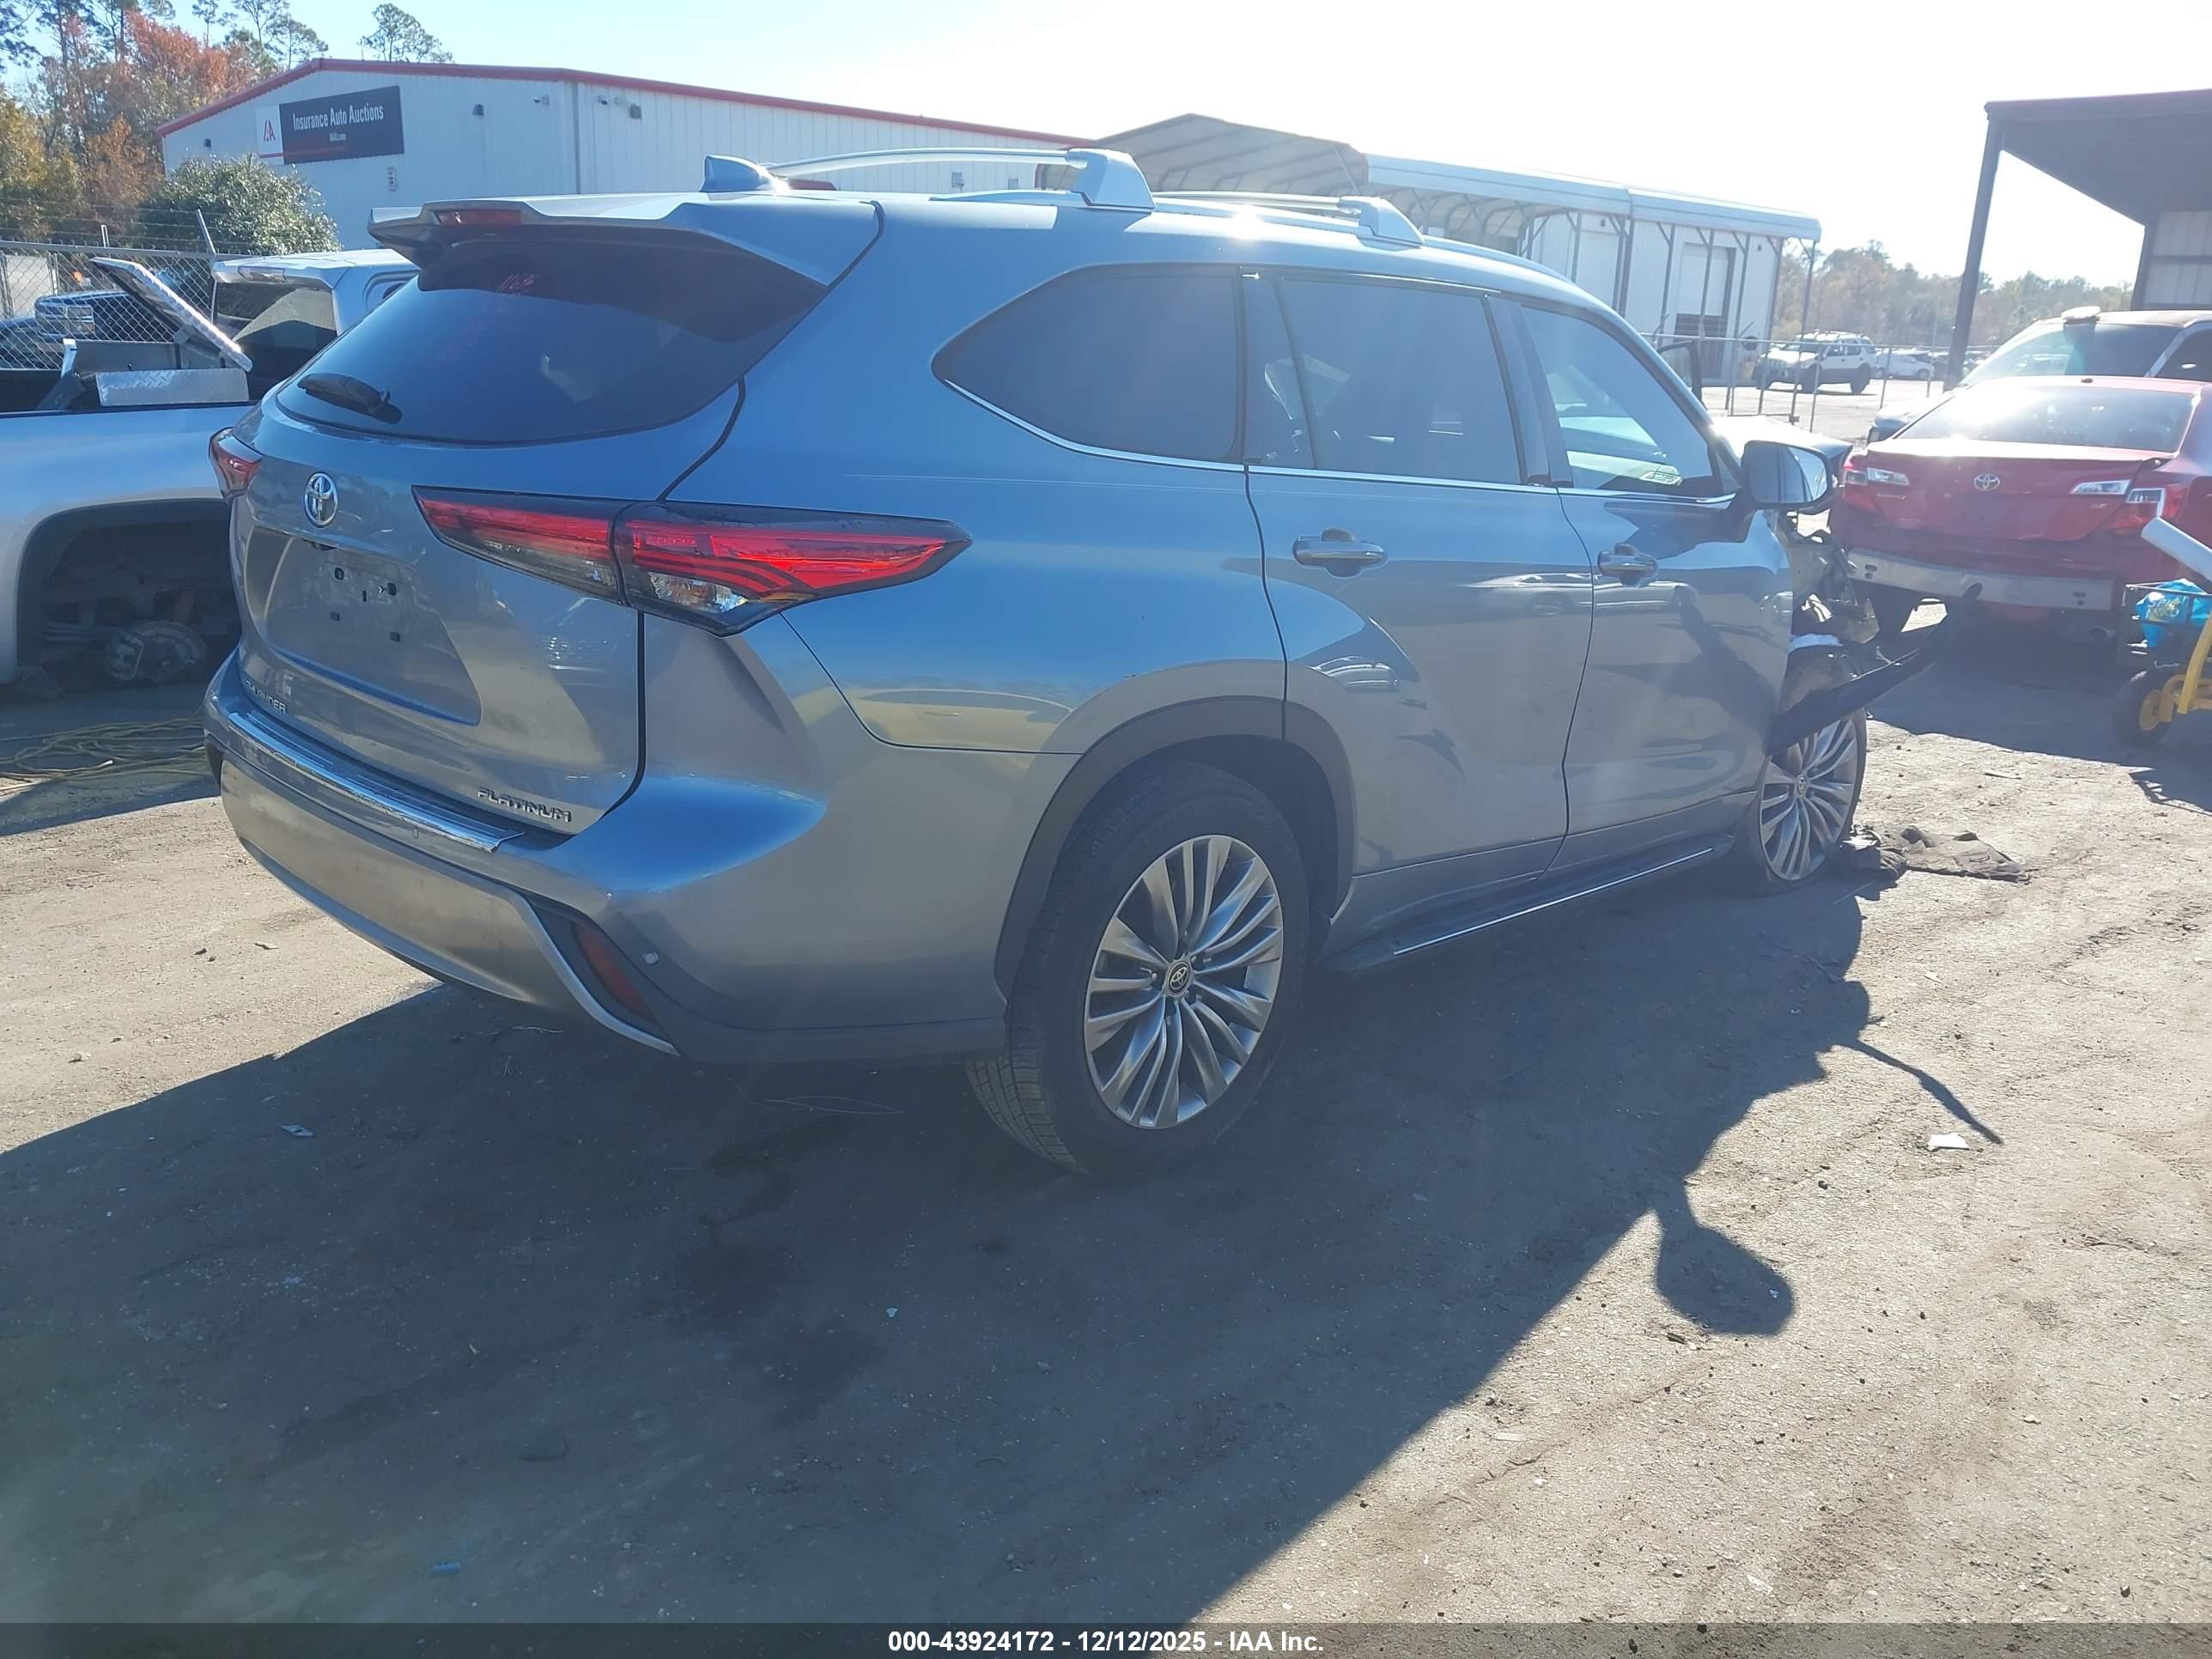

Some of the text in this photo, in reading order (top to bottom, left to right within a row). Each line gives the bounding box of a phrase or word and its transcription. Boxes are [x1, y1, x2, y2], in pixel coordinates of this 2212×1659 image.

[293, 103, 384, 131] Insurance Auto Auctions
[477, 786, 573, 823] PLATINUM
